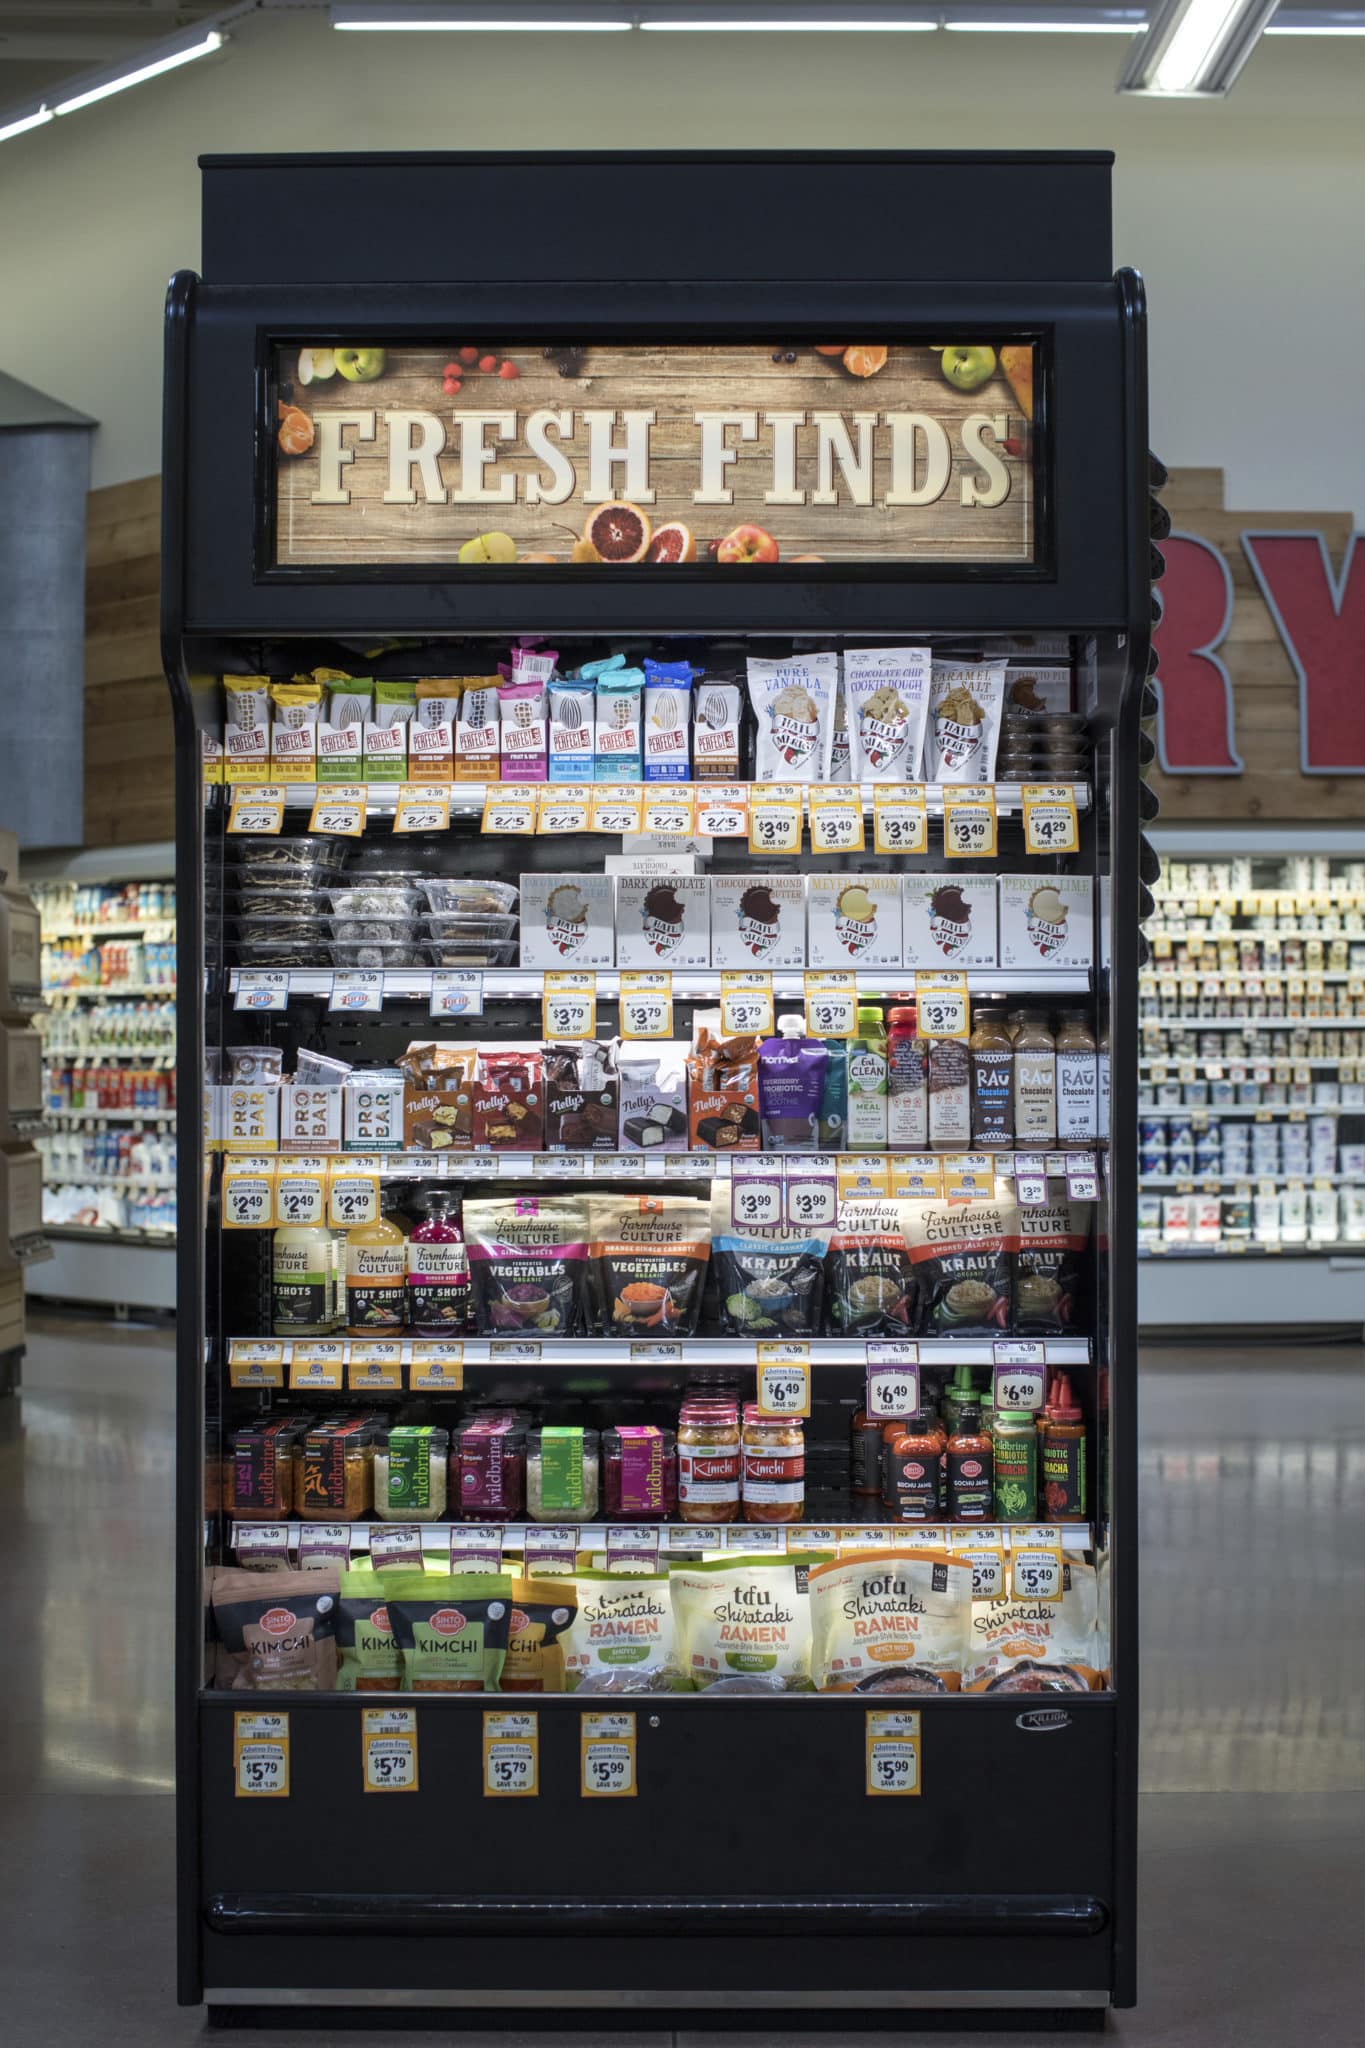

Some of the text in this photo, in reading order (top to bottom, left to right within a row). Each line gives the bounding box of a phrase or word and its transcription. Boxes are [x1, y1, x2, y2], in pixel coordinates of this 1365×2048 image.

[311, 410, 1011, 507] FRESH FINDS
[776, 668, 809, 678] PURE
[850, 668, 924, 679] CHOCOLATE CHIP
[932, 671, 991, 681] CARAMEL
[889, 680, 922, 691] DOUGH
[961, 682, 991, 693] SALT
[229, 733, 256, 753] PERFECT
[275, 733, 302, 753] PERFECT
[414, 731, 440, 751] PERFECT
[554, 731, 582, 752] PERFECT
[599, 732, 626, 752] PERFECT
[648, 733, 675, 753] PERFECT
[622, 879, 705, 889] DARK CHOCOLATE
[851, 1067, 884, 1076] CLEAN
[977, 1088, 1008, 1096] Chocolate
[495, 1218, 559, 1233] Farmhouse
[619, 1216, 682, 1232] Farmhouse
[921, 1207, 1000, 1226] Farmhouse
[496, 1234, 560, 1243] CULTURE
[620, 1232, 682, 1241] CULTURE
[927, 1222, 1003, 1240] CULTURE
[358, 1263, 403, 1273] CULTURE
[418, 1261, 464, 1270] CULTURE
[612, 1262, 686, 1273] VEGETABLES
[742, 1256, 800, 1269] KRAUT
[846, 1253, 901, 1266] KRAUT
[942, 1255, 997, 1273] KRAUT
[490, 1265, 565, 1277] VEGETABLES
[279, 1287, 310, 1296] SHOTS
[355, 1291, 374, 1299] GUT
[415, 1288, 465, 1296] GUT SHOTS
[258, 1439, 273, 1505] wildbrine
[329, 1439, 343, 1505] wildbrine
[413, 1439, 428, 1505] wildbrine
[486, 1437, 500, 1504] wildbrine
[566, 1440, 581, 1505] wildbrine
[646, 1441, 662, 1507] wildbrine
[693, 1458, 733, 1476] Kimchi
[746, 1458, 785, 1475] Kimchi
[862, 1576, 906, 1597] tofu
[584, 1597, 666, 1622] Shirataki
[714, 1603, 793, 1624] Shirataki
[843, 1594, 926, 1619] Shirataki
[854, 1616, 918, 1637] RAMEN
[974, 1602, 1055, 1633] Shirataki
[590, 1617, 658, 1637] RAMEN
[720, 1625, 786, 1642] RAMEN
[986, 1621, 1050, 1641] RAMEN
[252, 1636, 310, 1655] KIMCHI
[420, 1639, 477, 1654] KIMCHI
